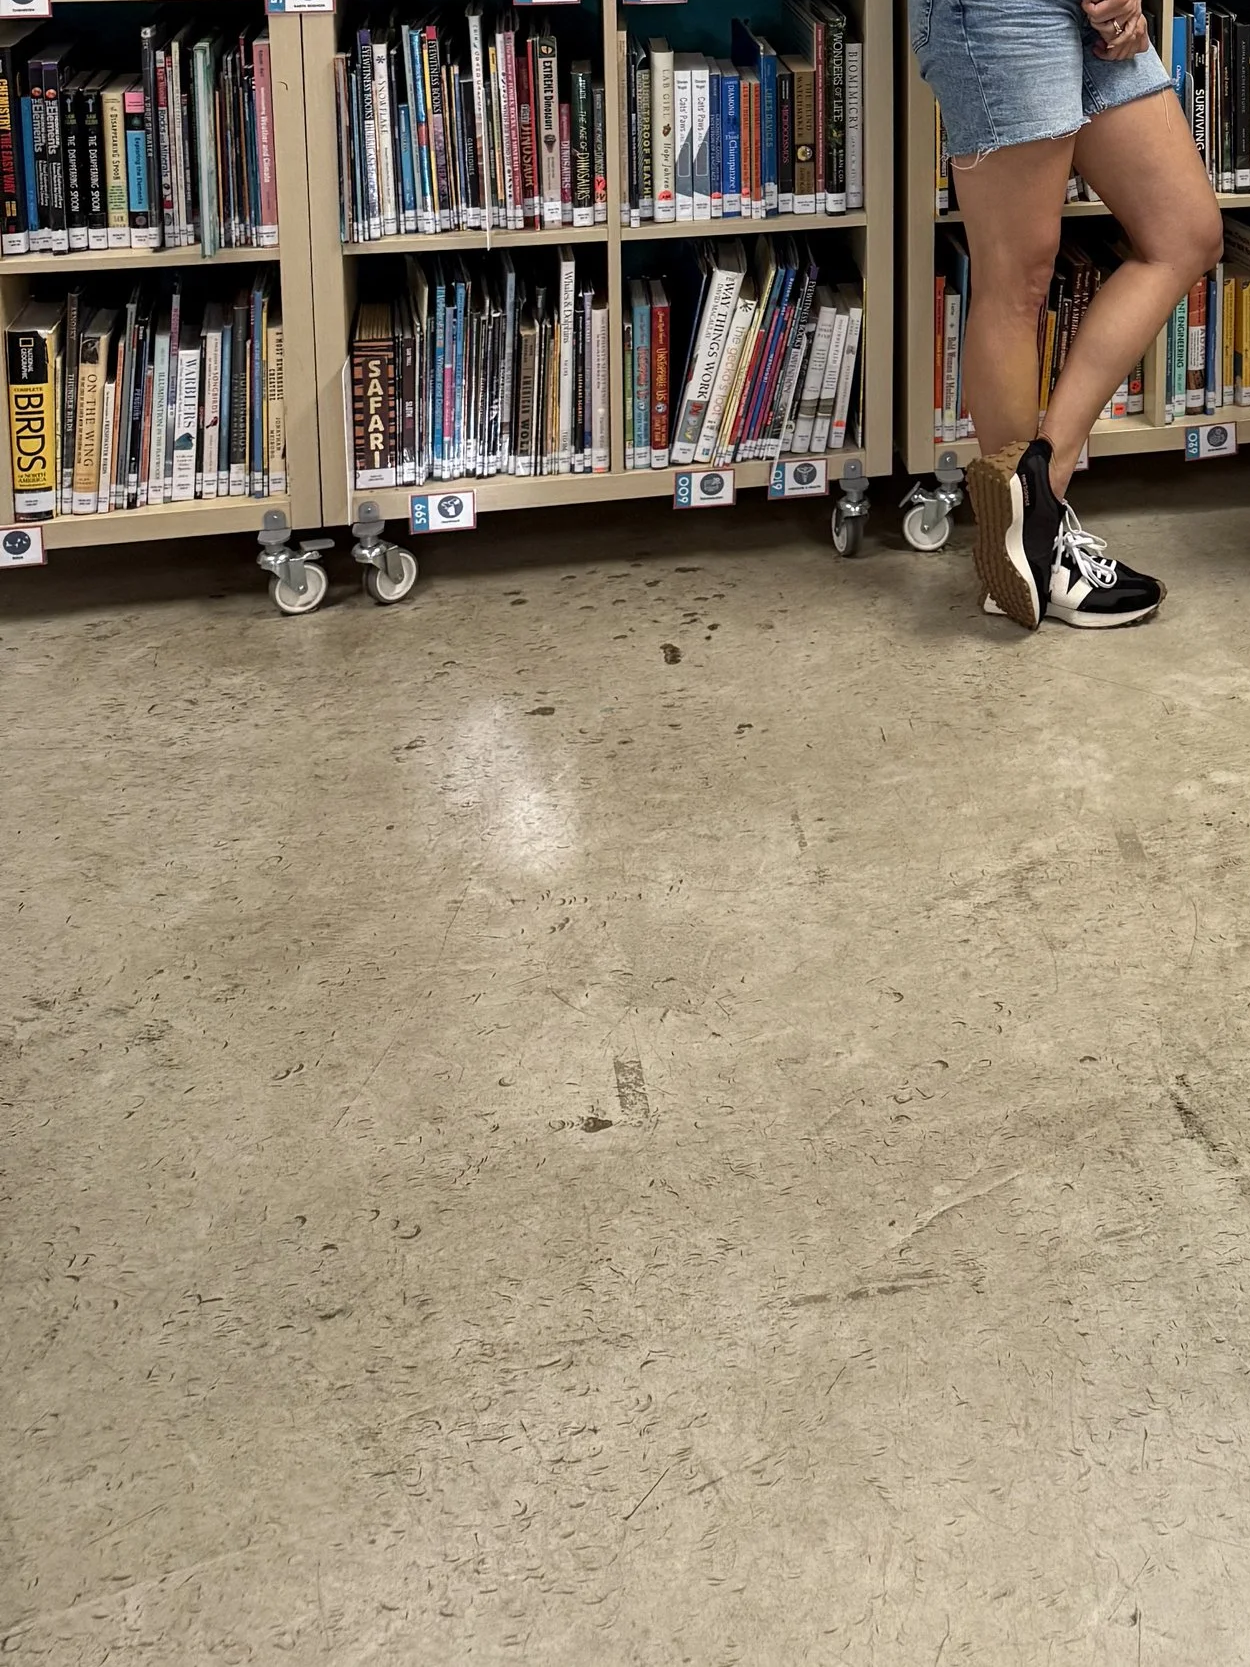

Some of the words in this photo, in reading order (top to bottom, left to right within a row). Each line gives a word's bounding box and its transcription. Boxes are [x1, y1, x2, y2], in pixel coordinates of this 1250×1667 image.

[543, 60, 553, 94] EXTREME
[833, 32, 844, 88] WONDERS
[1, 79, 11, 131] CHEMISTRY
[377, 78, 389, 135] SNOWFLAKE
[662, 93, 671, 119] GIRL
[728, 84, 736, 116] DIAMOND
[848, 51, 858, 130] BIOMIMICRY
[32, 104, 44, 153] Elements
[159, 110, 167, 134] Rocks
[680, 115, 688, 132] Paws
[697, 114, 705, 131] Paws
[833, 97, 844, 123] LIFE
[1194, 89, 1205, 151] SURVIVING
[47, 105, 58, 155] Elements
[110, 113, 119, 158] DISAPPEARING
[68, 149, 78, 188] DISAPPEARING
[89, 149, 99, 188] DISAPPEARING
[134, 137, 142, 165] Exploring
[561, 140, 571, 189] DINOSAURS
[728, 139, 738, 188] Chimpanzee
[576, 152, 590, 201] DINOSAURS
[71, 190, 79, 212] SPOON
[92, 190, 100, 212] SPOON
[563, 271, 573, 300] Whales
[562, 309, 573, 344] Dolphins
[707, 313, 727, 358] THINGS
[1176, 313, 1186, 368] ENGINEERING
[20, 347, 28, 380] GEOGRAPHIC
[697, 362, 715, 400] WORK
[67, 373, 75, 410] THUNDER
[87, 374, 98, 393] ON
[157, 371, 166, 427] ILLUMINATION
[183, 358, 198, 428] WARBLERS
[211, 371, 220, 414] SONGBIRDS
[521, 375, 532, 414] AMERICAN
[66, 411, 74, 432] BIRDS
[85, 399, 96, 425] THE
[133, 388, 142, 421] PENGUINS
[366, 359, 384, 468] SAFARI
[14, 393, 47, 472] BIRDS
[84, 430, 95, 468] WING
[519, 419, 530, 455] WOLF
[677, 476, 690, 503] 600
[415, 503, 427, 524] 599
